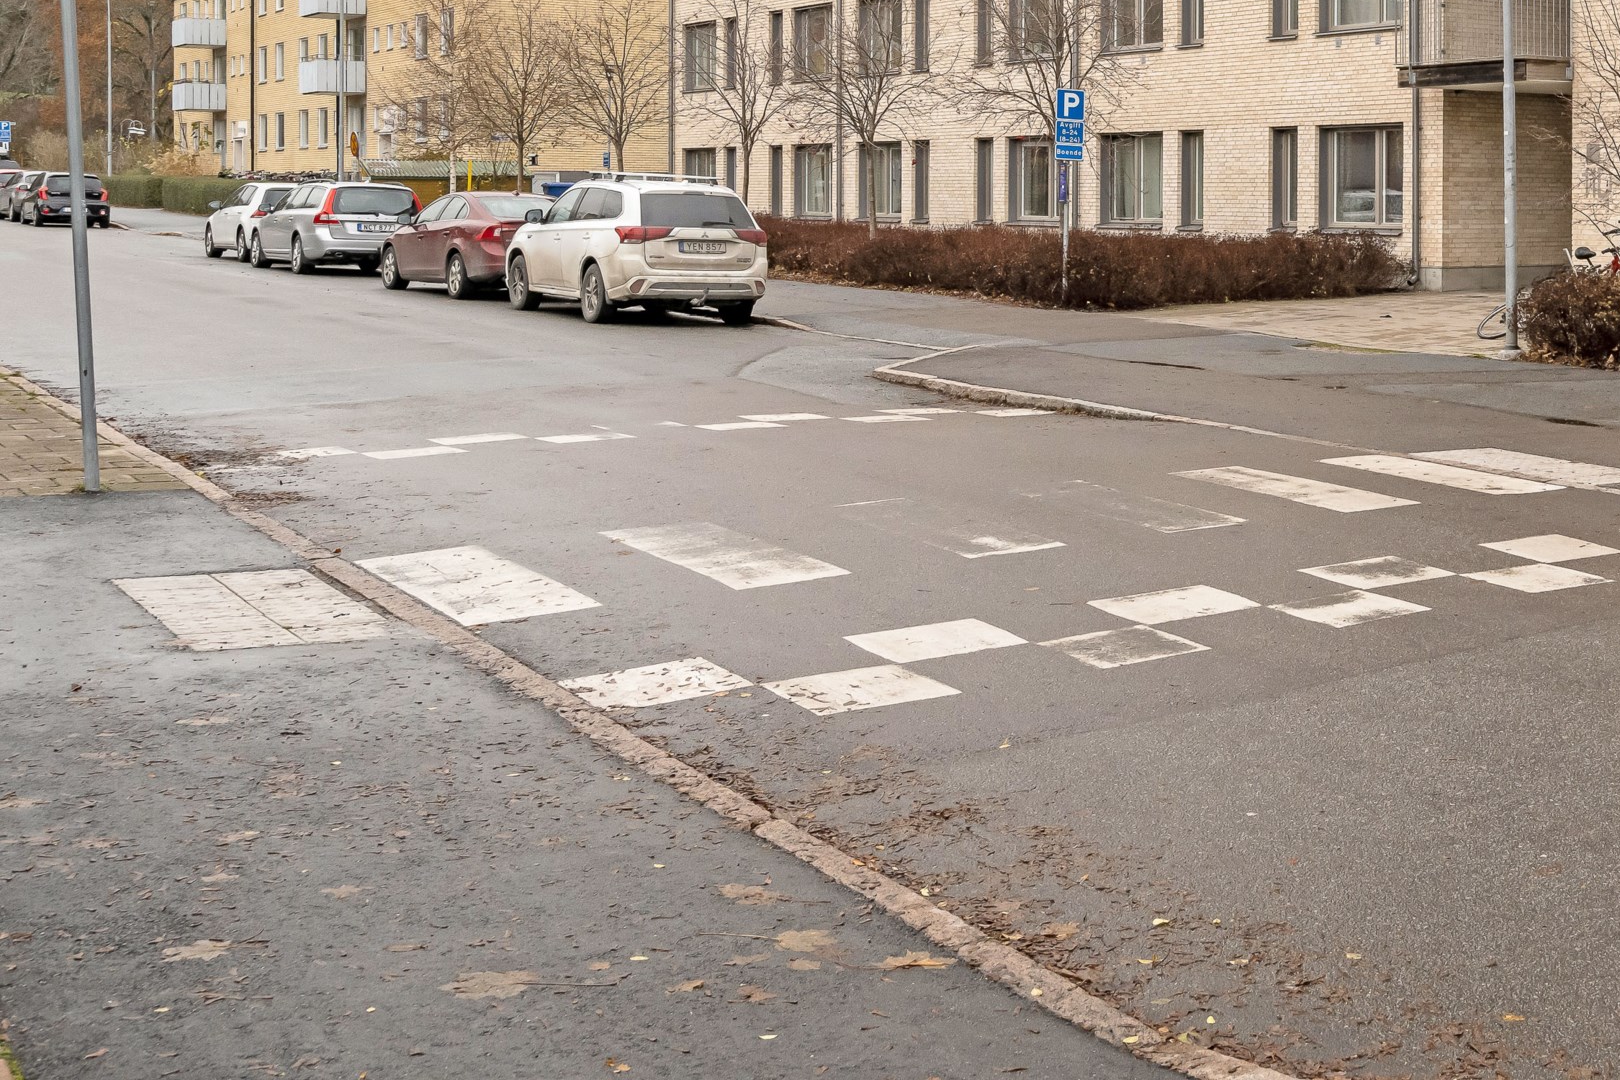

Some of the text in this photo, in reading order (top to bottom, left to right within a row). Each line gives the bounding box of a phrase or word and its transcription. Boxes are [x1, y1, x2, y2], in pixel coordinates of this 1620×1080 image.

[1063, 92, 1080, 116] P
[687, 242, 722, 251] YEN 857
